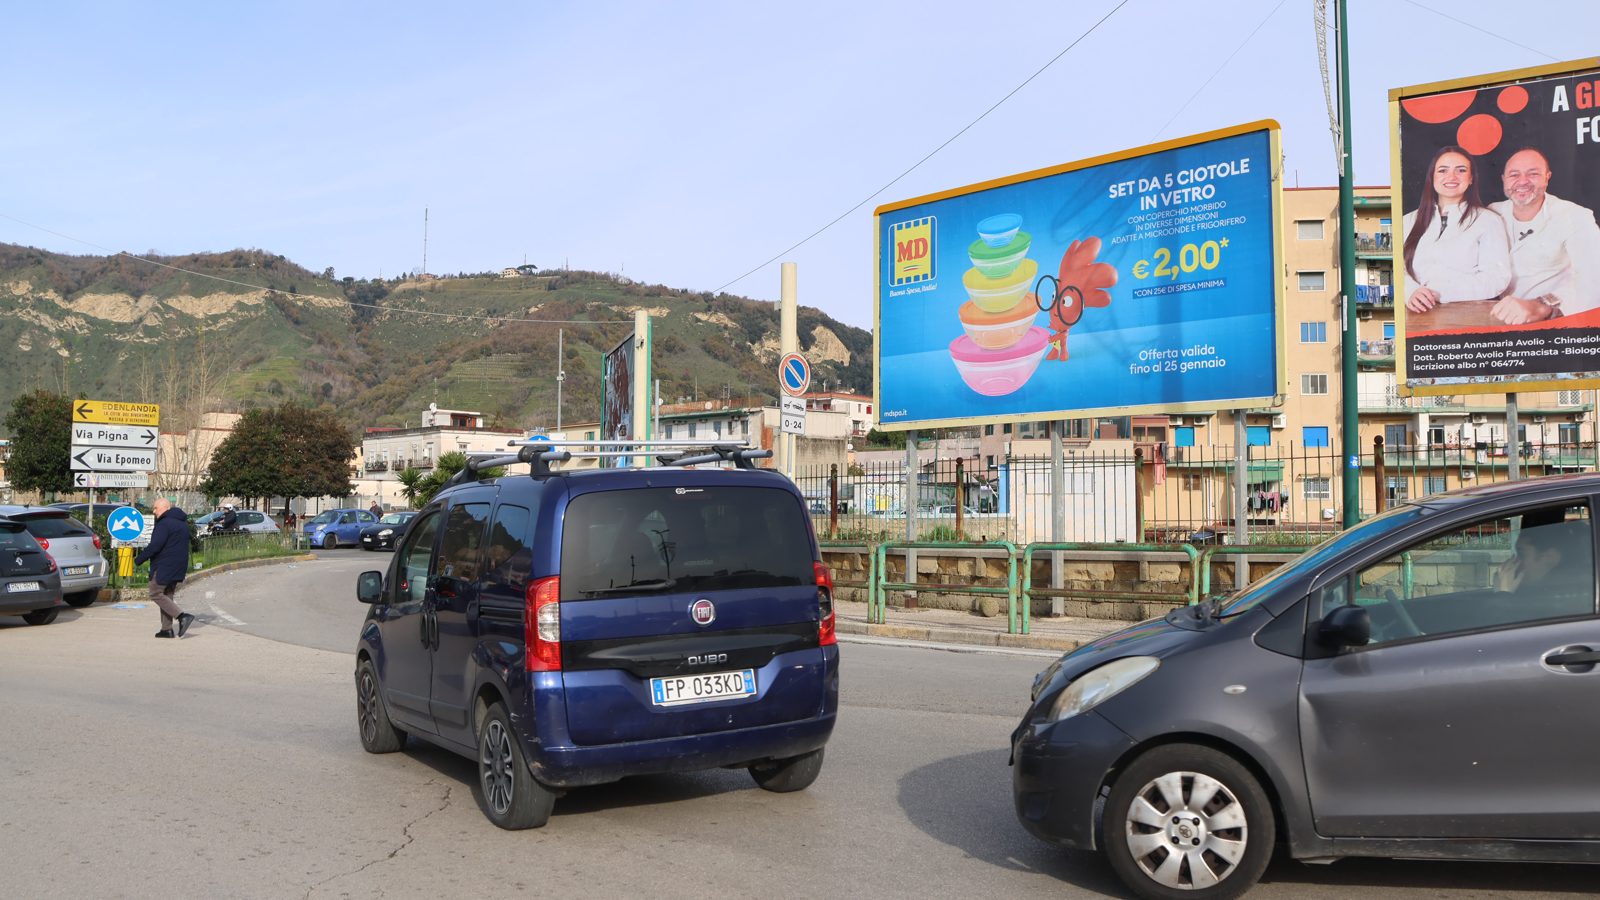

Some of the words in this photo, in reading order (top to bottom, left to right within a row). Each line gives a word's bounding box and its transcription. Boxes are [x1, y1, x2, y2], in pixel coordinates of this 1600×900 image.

[1552, 85, 1570, 113] A
[1109, 181, 1136, 199] SET
[1138, 176, 1162, 193] DA
[1164, 173, 1174, 188] 5
[1176, 158, 1250, 186] CIOTOLE
[1140, 194, 1158, 211] IN
[1160, 184, 1216, 207] VETRO
[1127, 215, 1145, 225] CON
[1145, 207, 1189, 222] COPERCHIO
[1190, 200, 1227, 215] MORBIDO
[1112, 233, 1138, 245] ADATTE
[1138, 232, 1144, 240] A
[1145, 225, 1190, 239] MICROONDE
[1191, 223, 1196, 232] E
[1197, 215, 1247, 231] FRIGORIFERO
[1135, 223, 1144, 232] IN
[1144, 218, 1174, 230] DIVERSE
[1174, 212, 1219, 225] DIMENSIONI
[897, 237, 928, 263] MD
[889, 289, 905, 297] Buona
[1153, 286, 1166, 295] 25€
[1167, 285, 1174, 293] DI
[1175, 283, 1196, 293] SPESA
[1198, 279, 1225, 289] MINIMA
[1413, 343, 1461, 351] Dottoressa
[1463, 339, 1513, 349] Annamaria
[1515, 338, 1545, 346] Avolio
[1554, 335, 1600, 344] Chinesiol
[1139, 348, 1178, 361] Offerta
[1180, 344, 1215, 357] valida
[1413, 354, 1436, 362] Dott.
[1437, 353, 1474, 361] Roberto
[1475, 350, 1504, 359] Avolio
[1506, 348, 1559, 358] Farmacista
[1129, 363, 1150, 375] fino
[1152, 362, 1162, 373] al
[1164, 360, 1178, 372] 25
[1180, 356, 1226, 373] gennaio
[1413, 362, 1455, 371] iscrizione
[1457, 361, 1477, 369] albo
[1490, 359, 1525, 368] 064774
[102, 403, 157, 412] EDENLANDIA
[75, 429, 93, 439] Via
[98, 430, 129, 441] Pigna
[97, 453, 112, 463] Via
[115, 454, 151, 466] Epomeo
[697, 607, 711, 619] FIAT
[688, 653, 728, 665] QUBO
[665, 680, 685, 699] FP
[693, 674, 743, 696] 033KD
